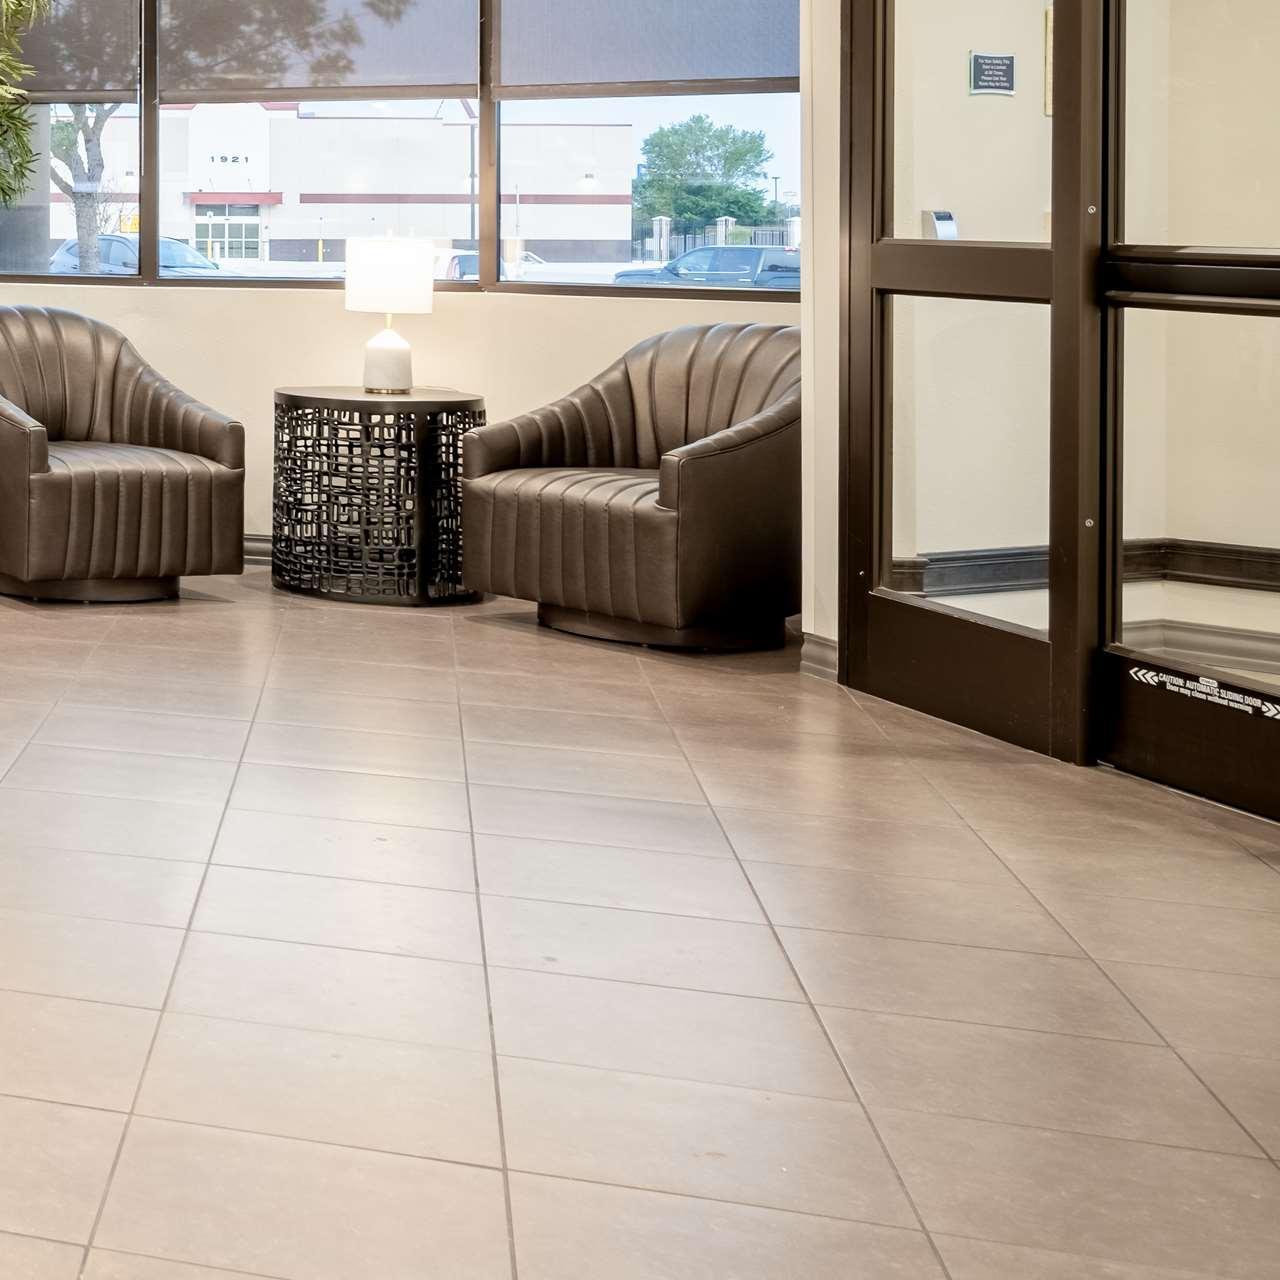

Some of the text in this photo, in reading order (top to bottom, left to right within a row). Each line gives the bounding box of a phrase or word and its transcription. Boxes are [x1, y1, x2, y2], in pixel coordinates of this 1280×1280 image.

[1158, 672, 1186, 687] CAUTION:
[1185, 680, 1221, 697] AUTOMATIC
[1220, 688, 1244, 703] SLIDING
[1244, 695, 1262, 708] DOOR
[1166, 681, 1253, 715] Door may close without warning
